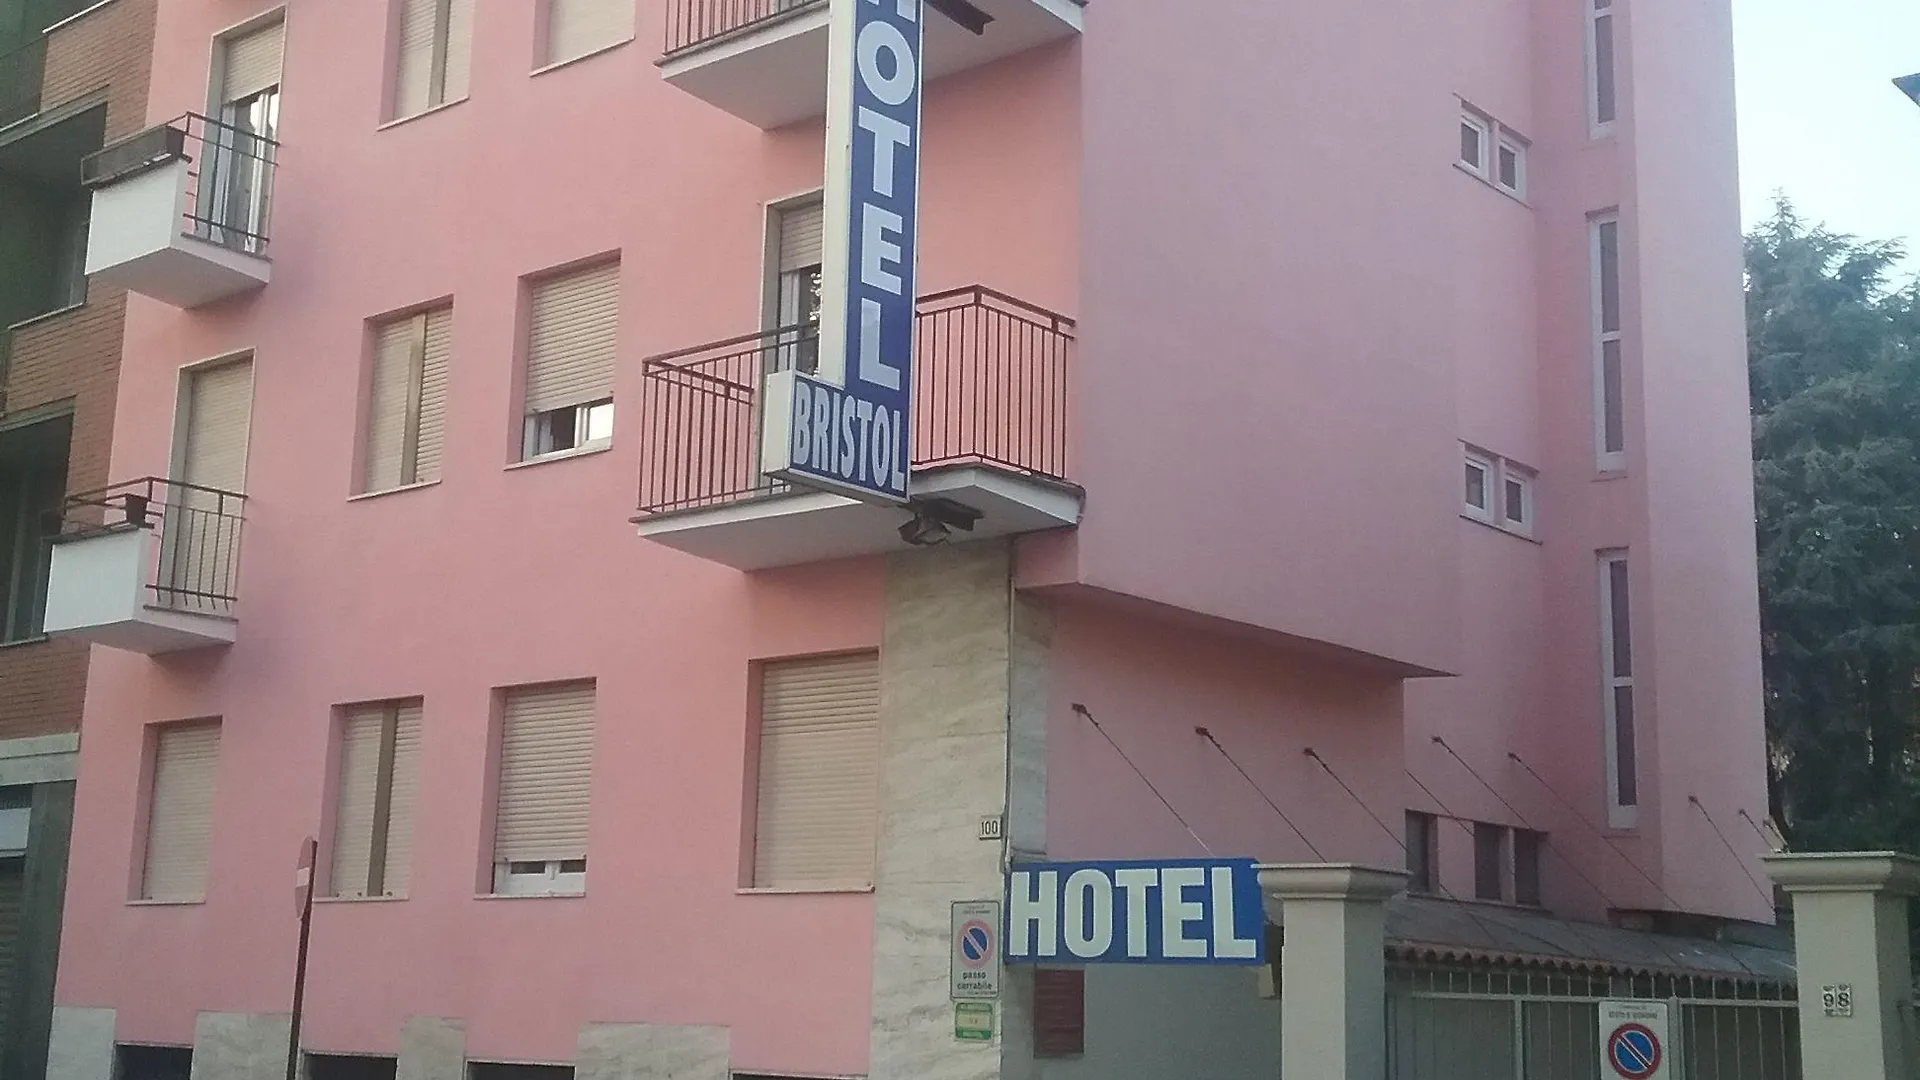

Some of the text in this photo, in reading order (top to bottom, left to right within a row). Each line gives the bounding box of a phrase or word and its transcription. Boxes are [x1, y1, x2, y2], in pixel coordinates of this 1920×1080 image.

[856, 0, 917, 391] OTEL
[793, 381, 905, 492] BRISTOL
[981, 820, 998, 835] 100
[1009, 867, 1257, 958] HOTEL
[962, 971, 987, 980] passo
[957, 981, 993, 990] carrabile
[1823, 992, 1850, 1007] 98
